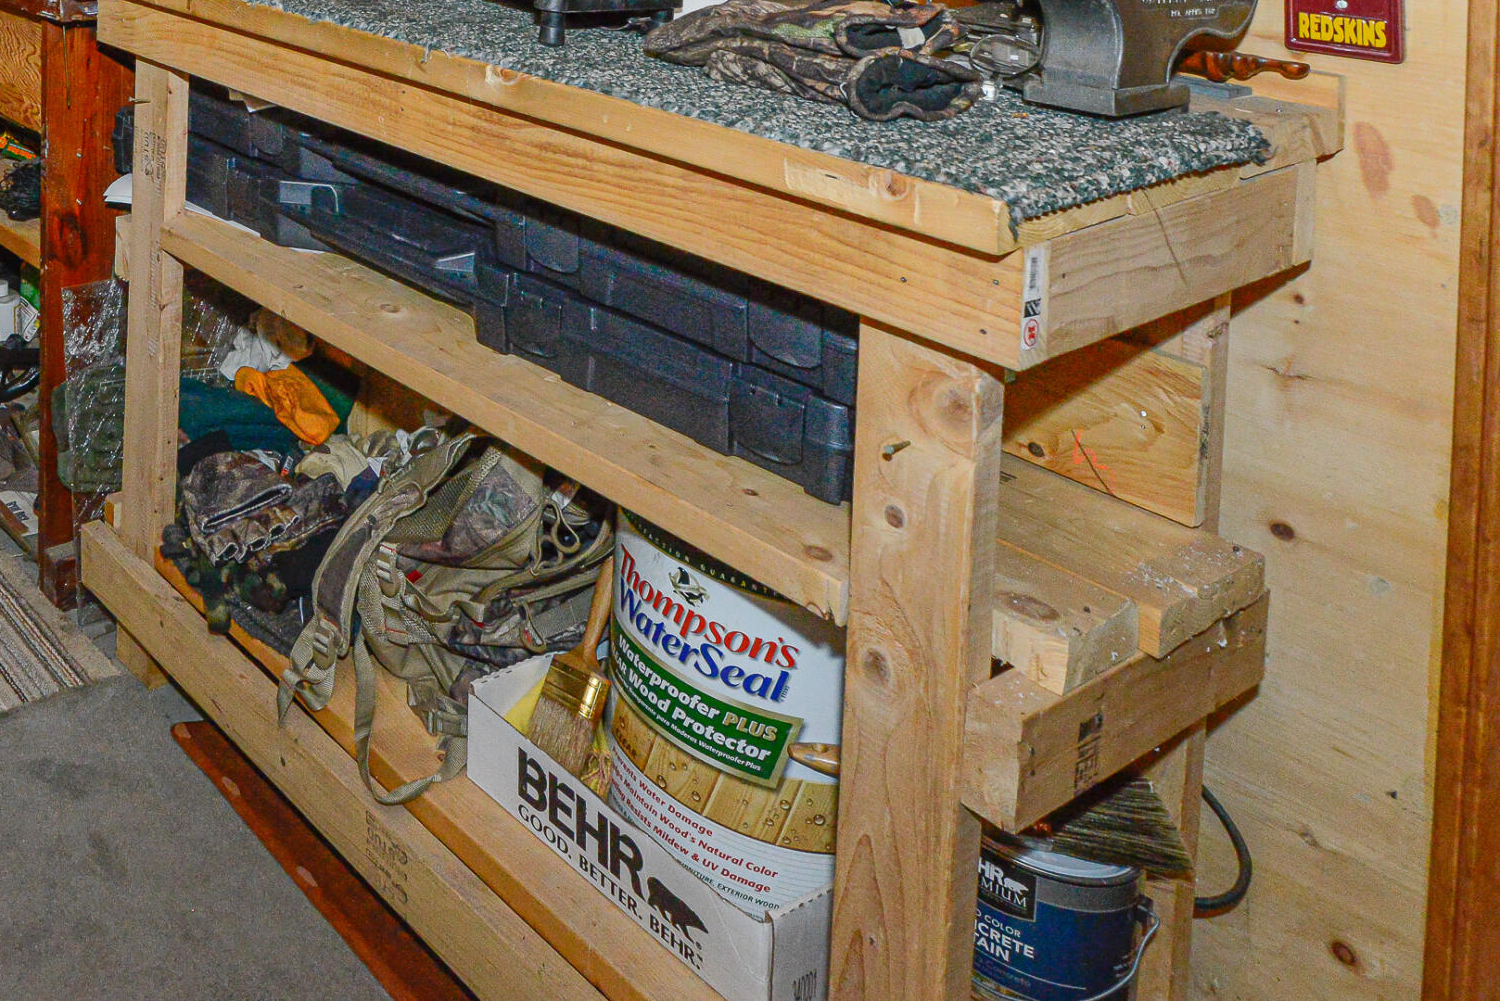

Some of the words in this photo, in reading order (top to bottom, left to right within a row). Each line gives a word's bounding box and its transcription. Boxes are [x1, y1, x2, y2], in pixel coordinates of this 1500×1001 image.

[1298, 12, 1387, 49] REDSKINS
[620, 543, 800, 669] Thompson's
[620, 577, 791, 702] WaterSeal
[618, 634, 721, 720] Waterproofer
[722, 711, 779, 743] PLUS
[628, 673, 672, 714] Wood
[671, 706, 772, 762] Protector
[517, 746, 647, 904] BEHR
[623, 775, 658, 819] Maintain
[659, 814, 696, 846] Wood's
[697, 838, 743, 867] Natural
[745, 862, 779, 879] Color
[626, 796, 652, 829] Resists
[652, 825, 690, 856] Mildew
[690, 853, 700, 863] &
[702, 858, 718, 872] UV
[720, 867, 772, 894] Damage
[639, 779, 666, 808] Water
[668, 805, 714, 838] Damage
[517, 803, 573, 860] GOOD.
[578, 854, 643, 921] BETTER.
[717, 882, 754, 903] EXTERIOR
[755, 898, 780, 911] WOOD
[984, 913, 1022, 939] COLOR
